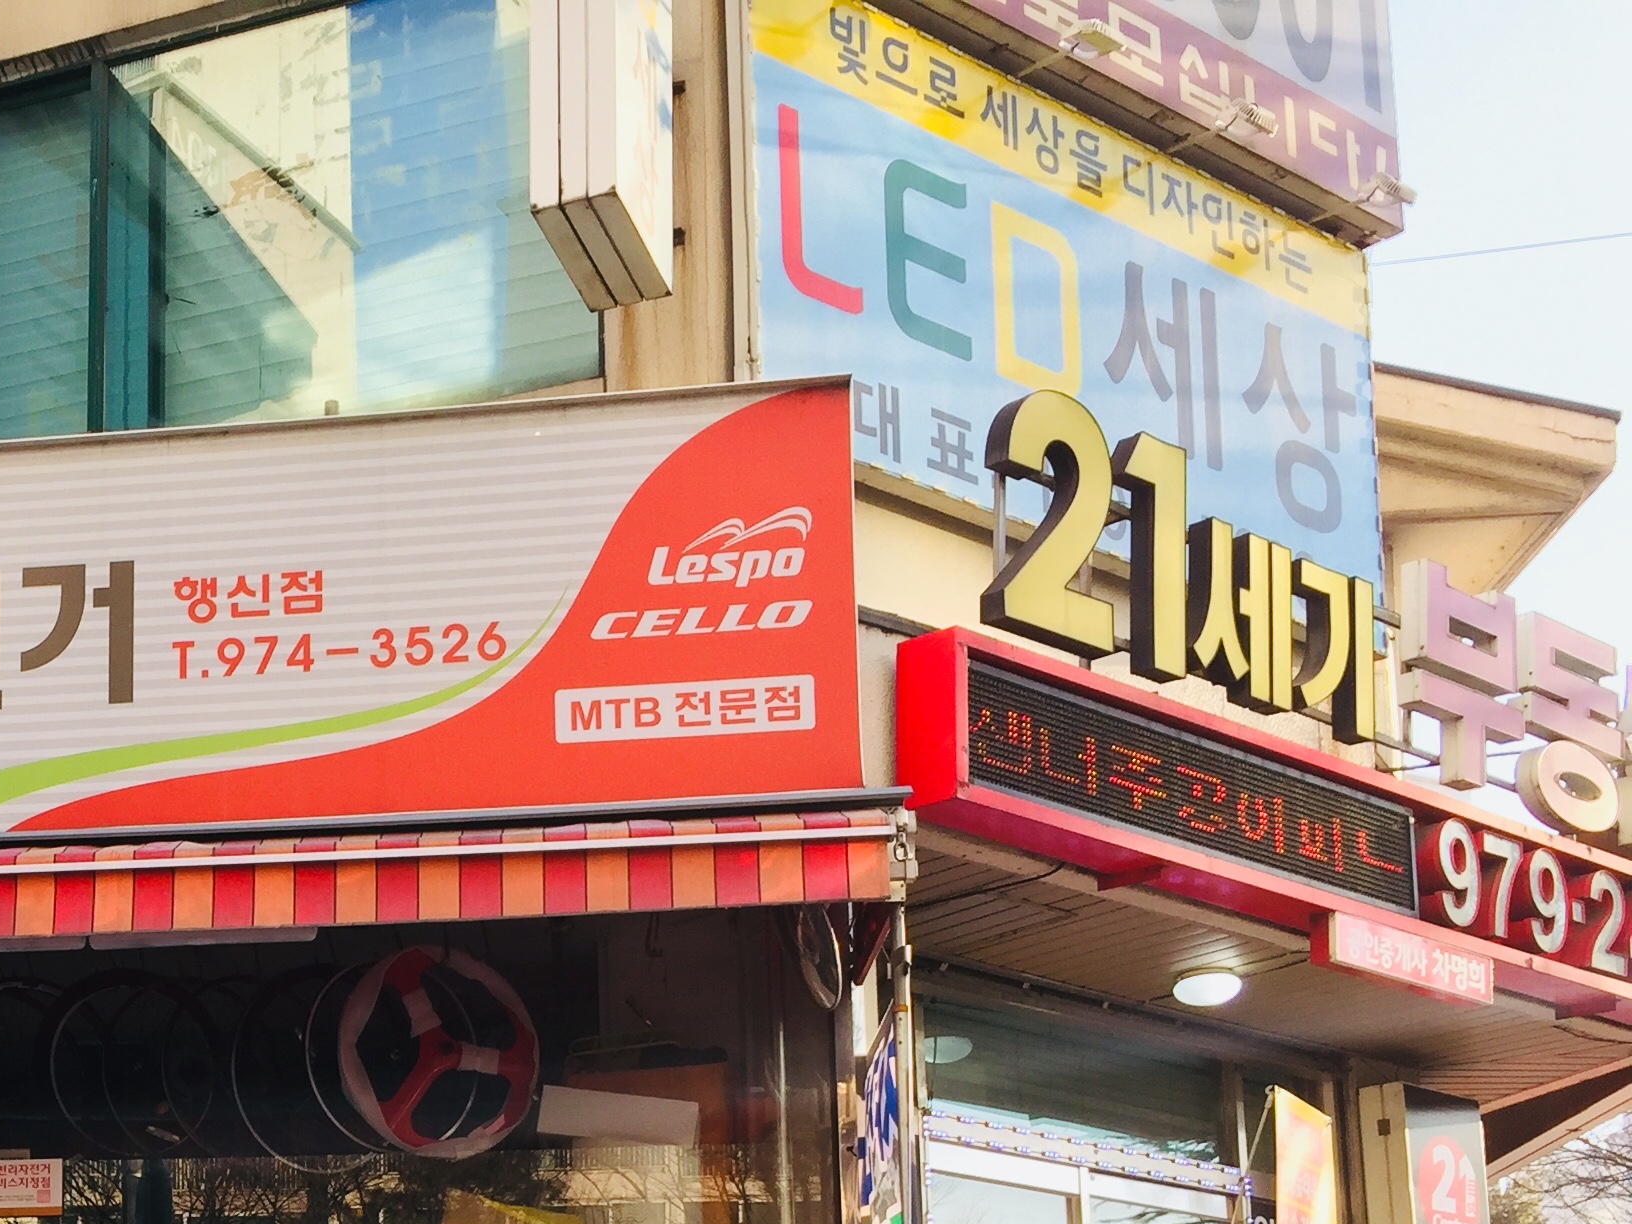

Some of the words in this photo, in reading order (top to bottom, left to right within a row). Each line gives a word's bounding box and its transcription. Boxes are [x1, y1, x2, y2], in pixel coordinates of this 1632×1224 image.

[829, 7, 966, 119] 빛으로
[980, 85, 1108, 198] 세상을
[1122, 153, 1313, 294] 디자인하는
[647, 545, 806, 589] Lespo
[980, 388, 1374, 744] 21세기
[173, 569, 325, 624] 행신점
[588, 599, 814, 641] CELLO
[172, 620, 507, 680] T.974-3526
[569, 694, 662, 733] MTB
[673, 681, 804, 728] 전문점
[1437, 817, 1632, 977] 979-2
